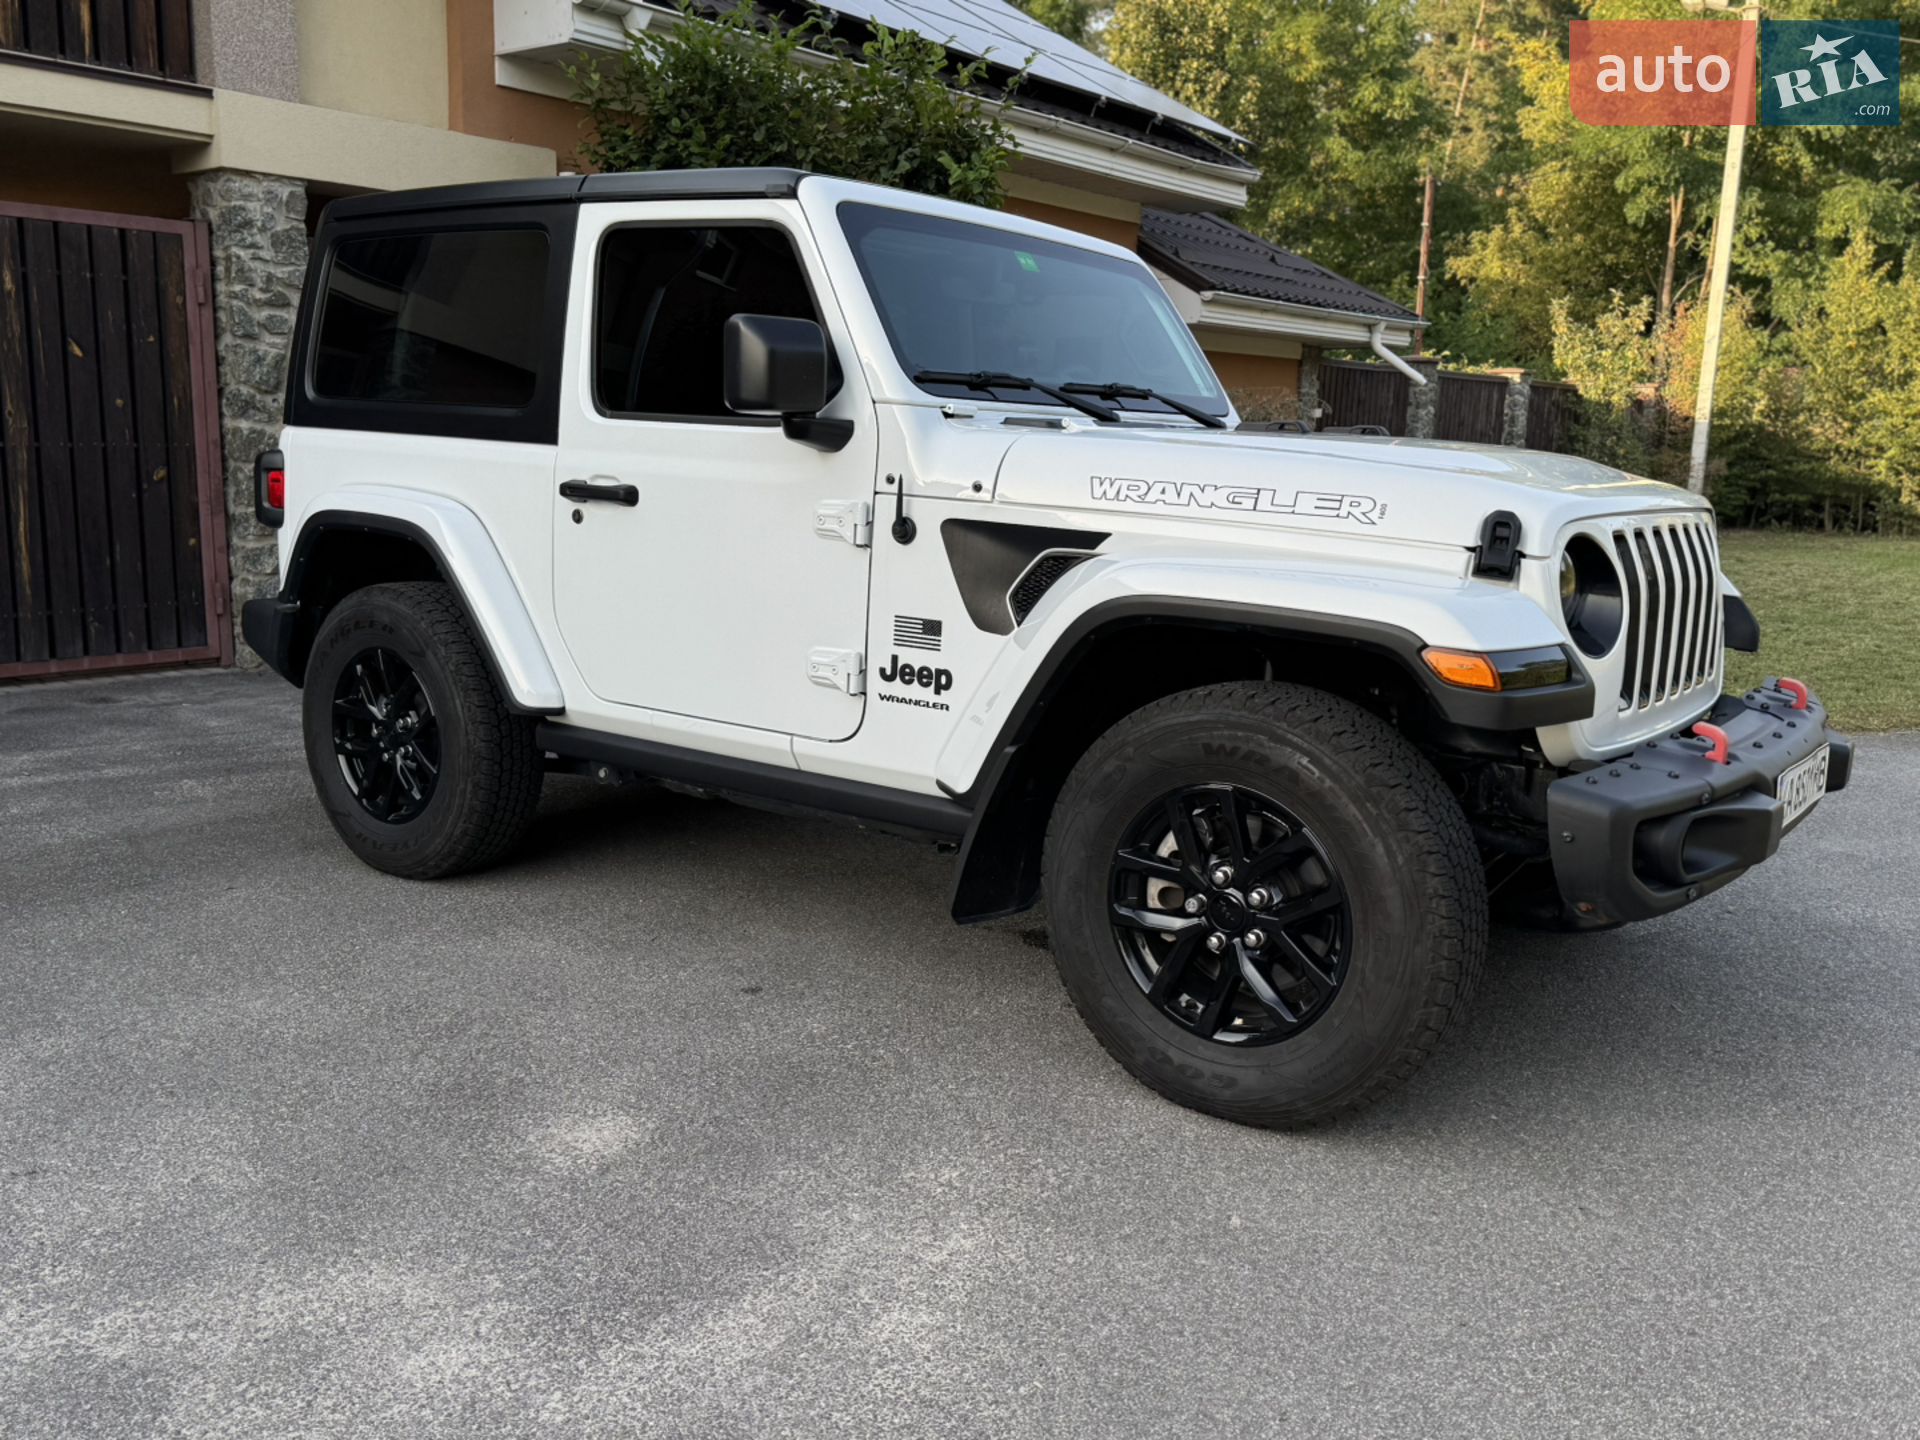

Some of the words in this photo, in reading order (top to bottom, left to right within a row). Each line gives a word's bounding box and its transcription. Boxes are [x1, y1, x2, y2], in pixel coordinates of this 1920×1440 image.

[1090, 475, 1377, 525] WRANGLER
[878, 654, 953, 696] Jeep
[878, 692, 950, 712] WRANGLER
